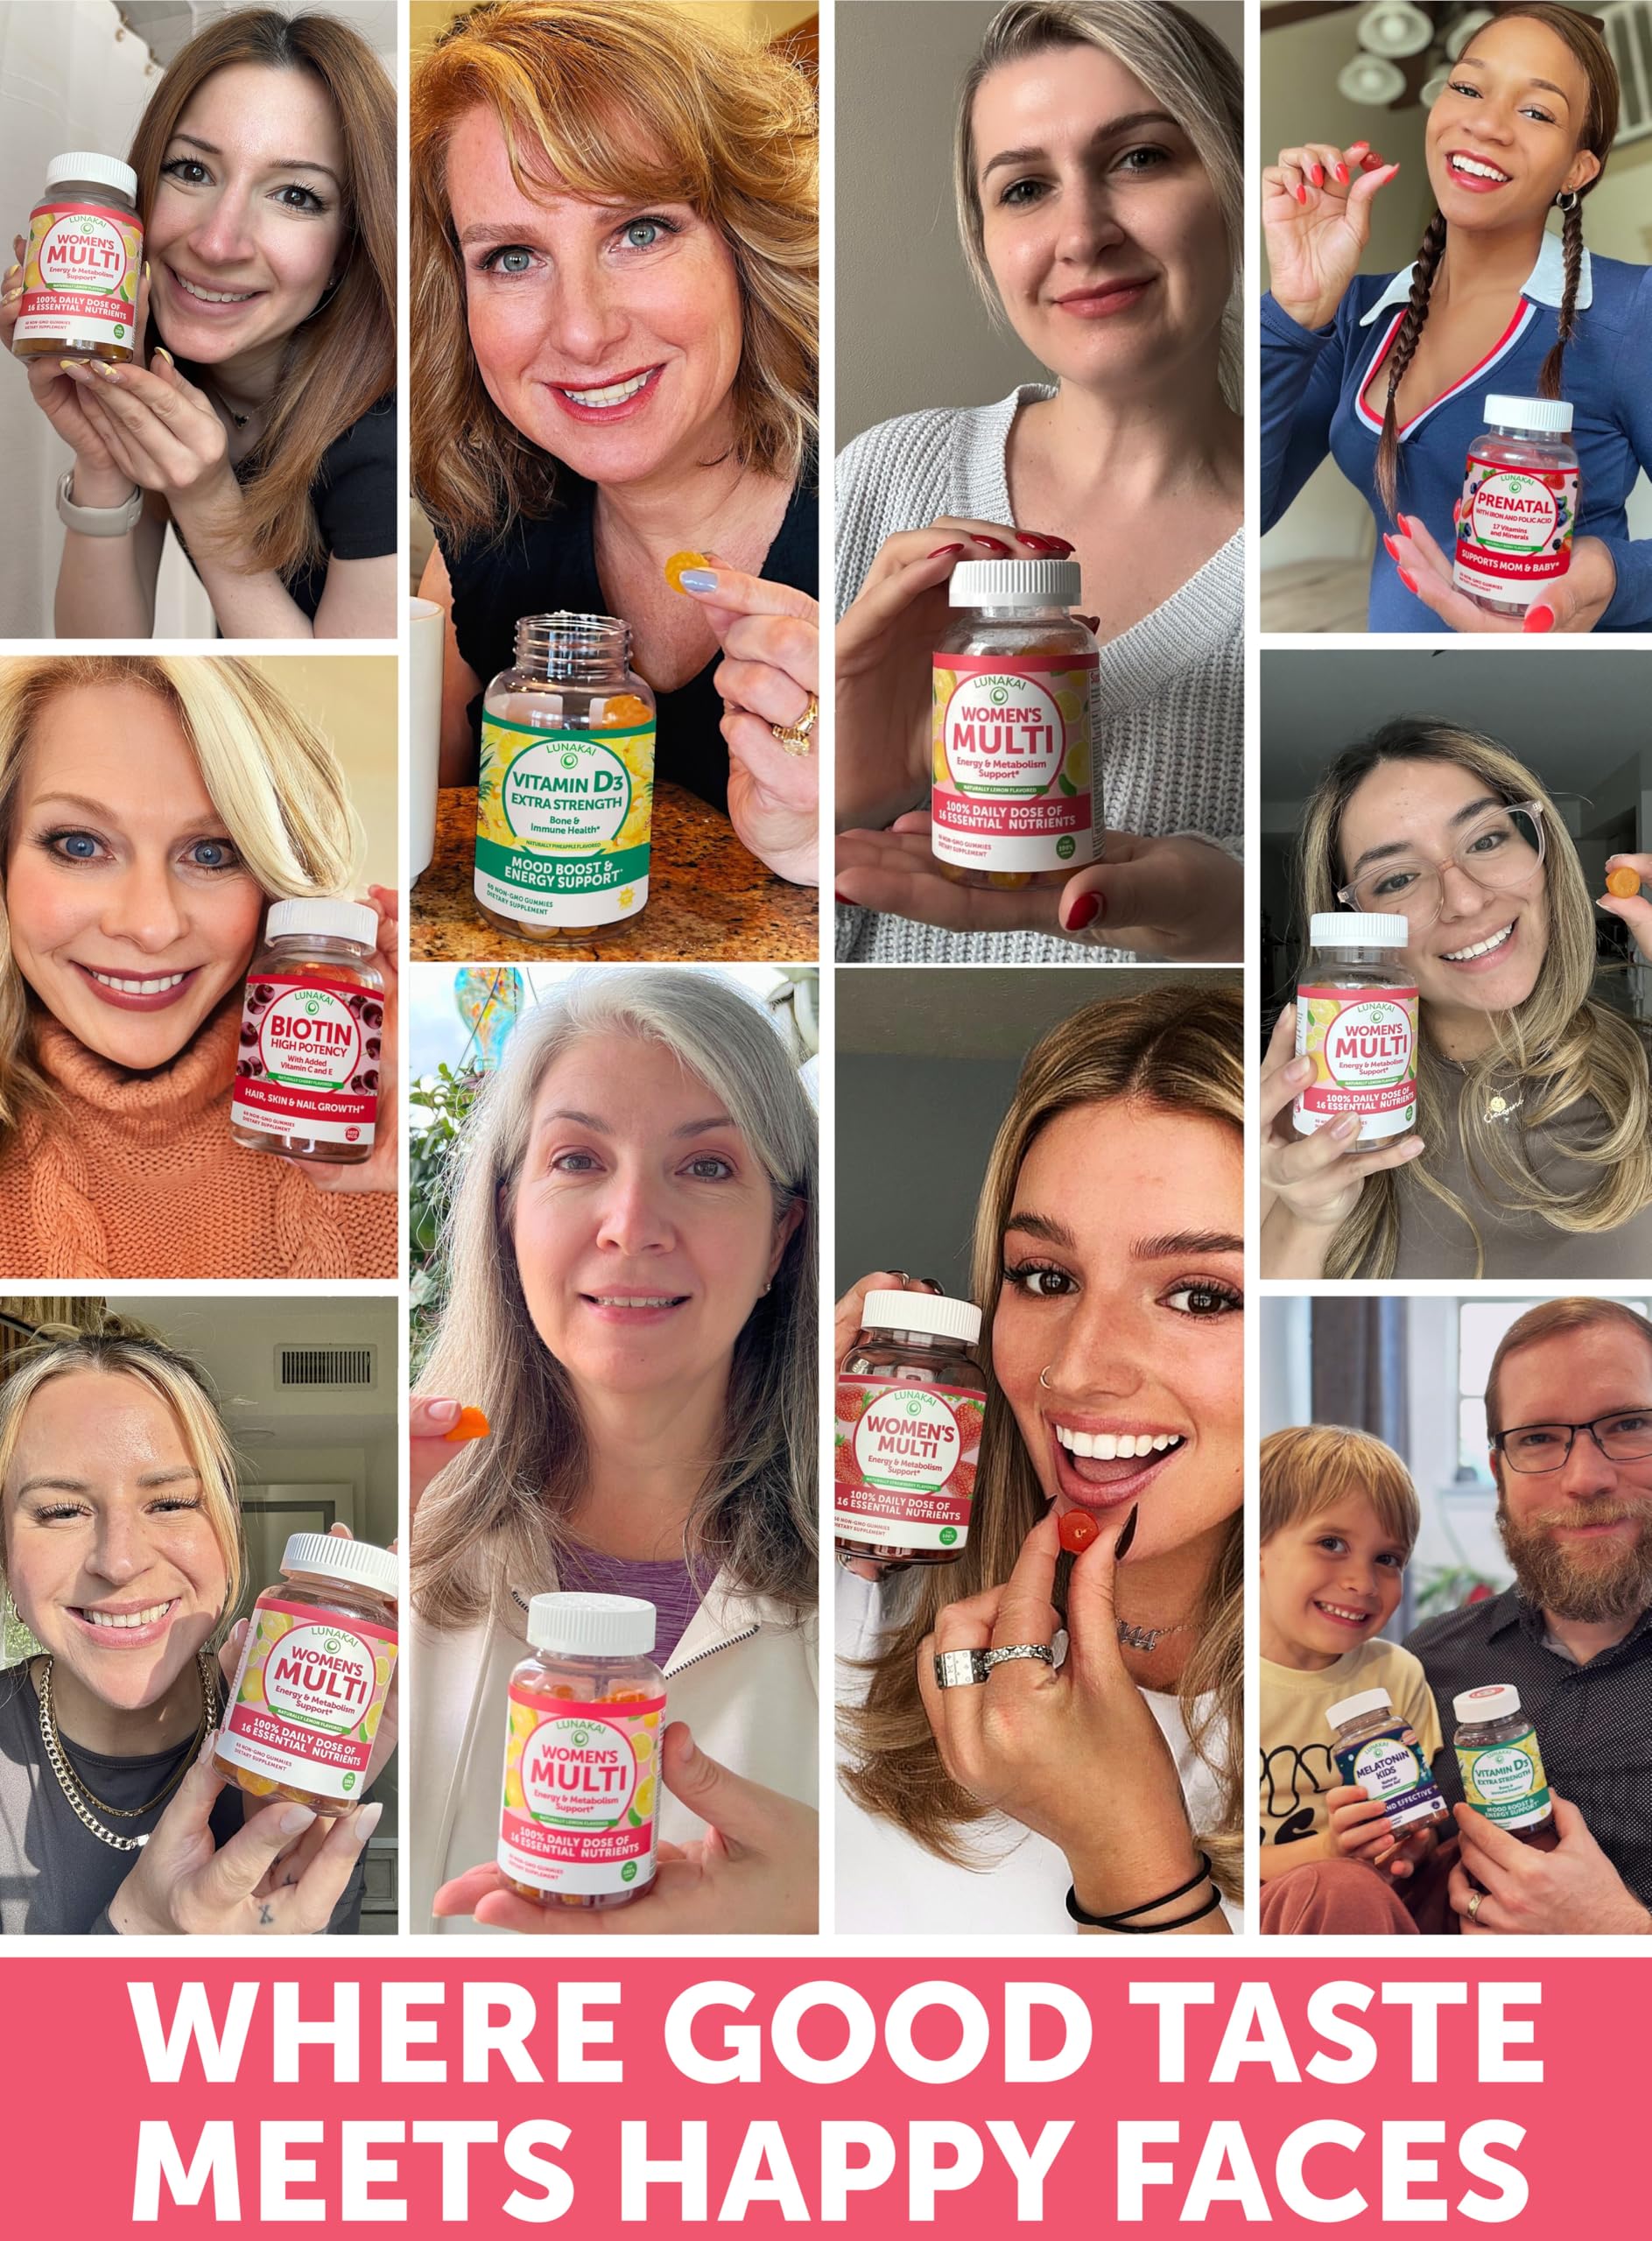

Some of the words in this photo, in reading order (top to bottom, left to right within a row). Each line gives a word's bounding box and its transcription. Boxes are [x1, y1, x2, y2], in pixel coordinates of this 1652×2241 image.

[69, 215, 107, 228] LUNAKAI
[58, 235, 114, 250] WOMEN'S
[47, 246, 120, 270] MULTI
[78, 269, 114, 278] Metabolism
[88, 299, 109, 307] DOSE
[85, 306, 126, 320] NUTRIENTS
[1501, 475, 1534, 486] LUNAKAI
[1478, 492, 1552, 514] PRENATAL
[1476, 509, 1488, 517] WITH
[1501, 525, 1527, 534] Vitamins
[1462, 550, 1498, 568] SUPPORTS
[1500, 561, 1523, 572] MOM
[974, 676, 1026, 691] LUNAKAI
[961, 706, 1042, 723] WOMEN'S
[953, 724, 1053, 754] MULTI
[546, 743, 596, 756] LUNAKAI
[957, 757, 983, 769] Energy
[513, 771, 588, 793] VITAMIN
[594, 770, 623, 793] D3
[511, 792, 552, 809] EXTRA
[554, 797, 622, 811] STRENGTH
[946, 801, 969, 814] 100%
[973, 806, 1006, 817] DAILY
[1010, 807, 1044, 818] DOSE
[1047, 805, 1063, 816] OF
[939, 810, 946, 820] 16
[948, 812, 1002, 829] ESSENTIAL
[1009, 816, 1075, 829] NUTRIENTS
[531, 824, 566, 834] Immune
[511, 856, 552, 874] MOOD
[556, 861, 601, 875] BOOST
[604, 861, 613, 871] &
[504, 867, 555, 887] ENERGY
[487, 890, 509, 904] DIETARY
[510, 899, 548, 915] SUPPLEMENT
[495, 886, 524, 902] NON-GMO
[525, 896, 553, 908] GUMMIES
[295, 991, 334, 1006] LUNAKAI
[1358, 1003, 1395, 1013] LUNAKAI
[271, 1015, 352, 1046] BIOTIN
[1346, 1023, 1402, 1036] WOMEN'S
[271, 1038, 297, 1051] HIGH
[299, 1043, 348, 1057] POTENCY
[1336, 1035, 1407, 1058] MULTI
[281, 1062, 306, 1072] Vitamin
[288, 1055, 304, 1064] With
[305, 1057, 327, 1066] Added
[1370, 1058, 1403, 1068] Metabolism
[245, 1088, 266, 1101] HAIR,
[268, 1094, 287, 1106] SKIN
[297, 1100, 316, 1110] NAIL
[1326, 1093, 1351, 1102] 100%
[1353, 1093, 1379, 1103] DAILY
[1381, 1089, 1401, 1099] DOSE
[1402, 1086, 1409, 1095] OF
[1381, 1092, 1414, 1107] NUTRIENTS
[895, 1391, 937, 1407] LUNAKAI
[868, 1416, 955, 1442] WOMEN'S
[877, 1436, 938, 1458] MULTI
[868, 1456, 893, 1465] Energy
[901, 1460, 942, 1471] Metabolism
[837, 1497, 848, 1506] 16
[851, 1500, 901, 1514] ESSENTIAL
[906, 1509, 961, 1520] NUTRIENTS
[850, 1491, 875, 1500] 100%
[878, 1495, 906, 1506] DAILY
[909, 1500, 934, 1509] DOSE
[311, 1626, 358, 1647] LUNAKAI
[292, 1646, 363, 1677] WOMEN'S
[274, 1658, 367, 1704] MULTI
[276, 1685, 302, 1700] Energy
[312, 1696, 355, 1714] Metabolism
[556, 1720, 607, 1734] LUNAKAI
[242, 1723, 251, 1732] 16
[252, 1728, 306, 1753] ESSENTIAL
[312, 1747, 361, 1766] NUTRIENTS
[253, 1718, 279, 1734] 100%
[282, 1728, 314, 1744] DAILY
[315, 1738, 343, 1753] DOSE
[345, 1745, 355, 1755] OF
[542, 1745, 618, 1763] WOMEN'S
[1366, 1742, 1388, 1754] LUNAKAI
[1356, 1751, 1409, 1778] MELATONIN
[1376, 1767, 1396, 1779] KIDS
[1475, 1766, 1513, 1777] VITAMIN
[1514, 1760, 1529, 1770] D3
[531, 1760, 627, 1792] MULTI
[1499, 1770, 1530, 1783] STRENGTH
[535, 1790, 560, 1803] Energy
[1508, 1801, 1529, 1811] BOOST
[511, 1833, 519, 1843] 16
[521, 1837, 575, 1857] ESSENTIAL
[581, 1843, 639, 1858] NUTRIENTS
[520, 1827, 545, 1841] 100%
[547, 1835, 580, 1846] DAILY
[583, 1837, 613, 1847] DOSE
[615, 1837, 629, 1845] OF
